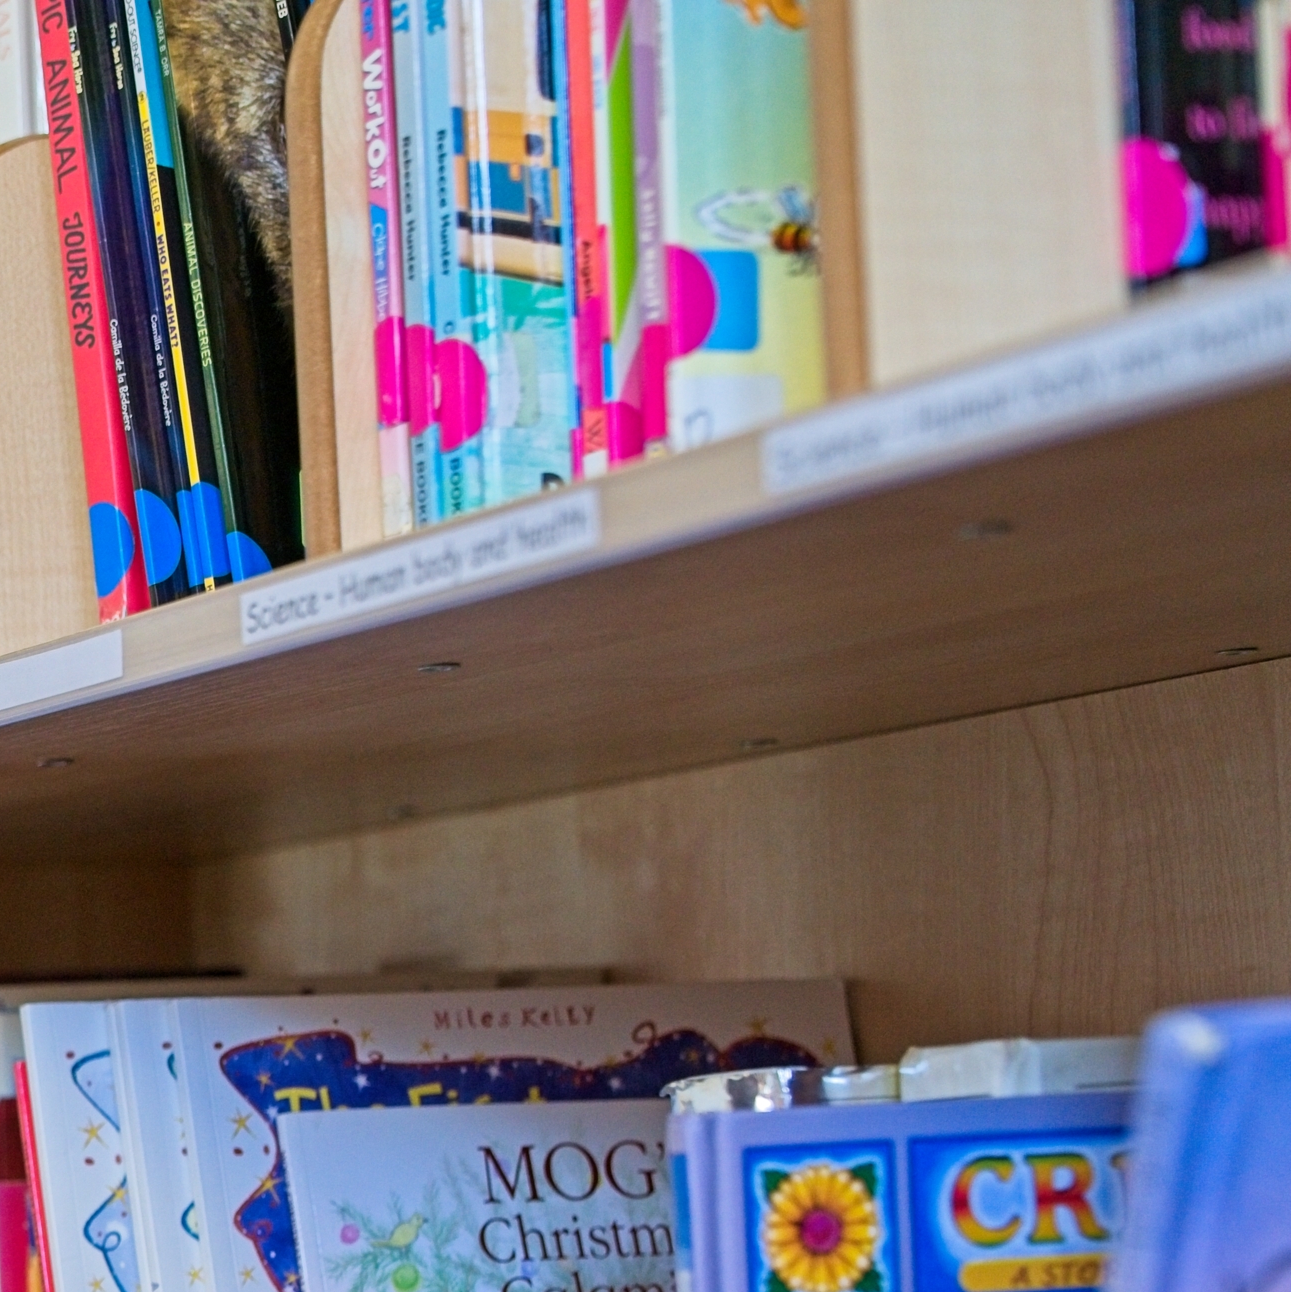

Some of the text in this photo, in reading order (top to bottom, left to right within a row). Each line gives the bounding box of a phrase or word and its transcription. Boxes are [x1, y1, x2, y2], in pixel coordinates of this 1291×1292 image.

[155, 9, 166, 43] TAMRA
[161, 56, 169, 77] ORR
[115, 64, 124, 90] Horse
[402, 136, 414, 214] Rebecca
[436, 130, 448, 209] Rebecca
[46, 59, 78, 195] ANIMAL
[62, 211, 96, 348] JOURNEYS
[141, 119, 179, 348] LAUBER/KELLER WHO EATS WHAT?
[405, 219, 416, 281] Hunter
[440, 214, 450, 277] Hunter
[182, 222, 213, 368] ANIMAL DISCOVERIES
[109, 318, 122, 356] Camilla
[115, 358, 124, 371] de
[150, 314, 163, 351] Camilla
[155, 353, 165, 367] de
[246, 595, 319, 635] Science
[339, 560, 407, 607] Human
[410, 544, 462, 590] body
[471, 527, 508, 569] and
[433, 1007, 511, 1030] Miles
[951, 1151, 1123, 1248] CR
